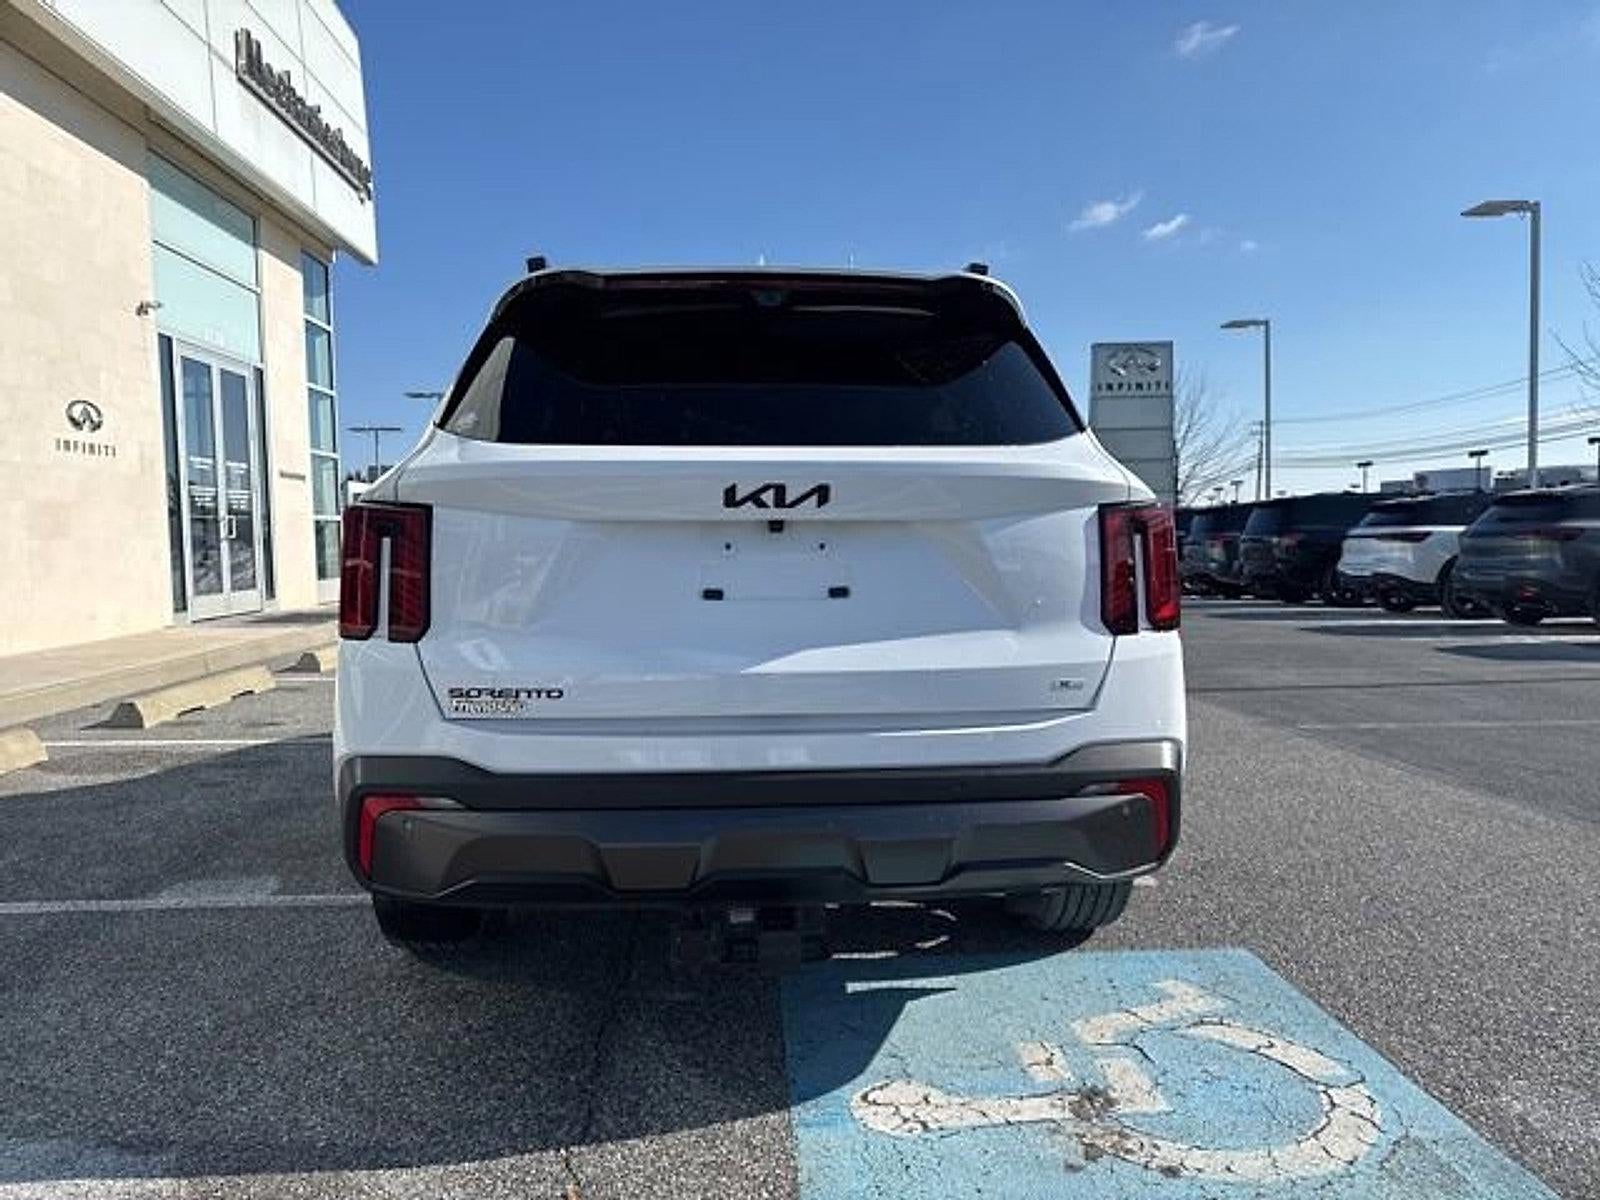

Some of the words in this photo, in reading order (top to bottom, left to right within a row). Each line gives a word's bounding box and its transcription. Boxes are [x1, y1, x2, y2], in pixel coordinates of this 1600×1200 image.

[1097, 380, 1169, 391] INFINITI
[55, 437, 117, 458] INFINITI
[723, 482, 830, 508] KIA
[448, 687, 564, 699] SORENTO
